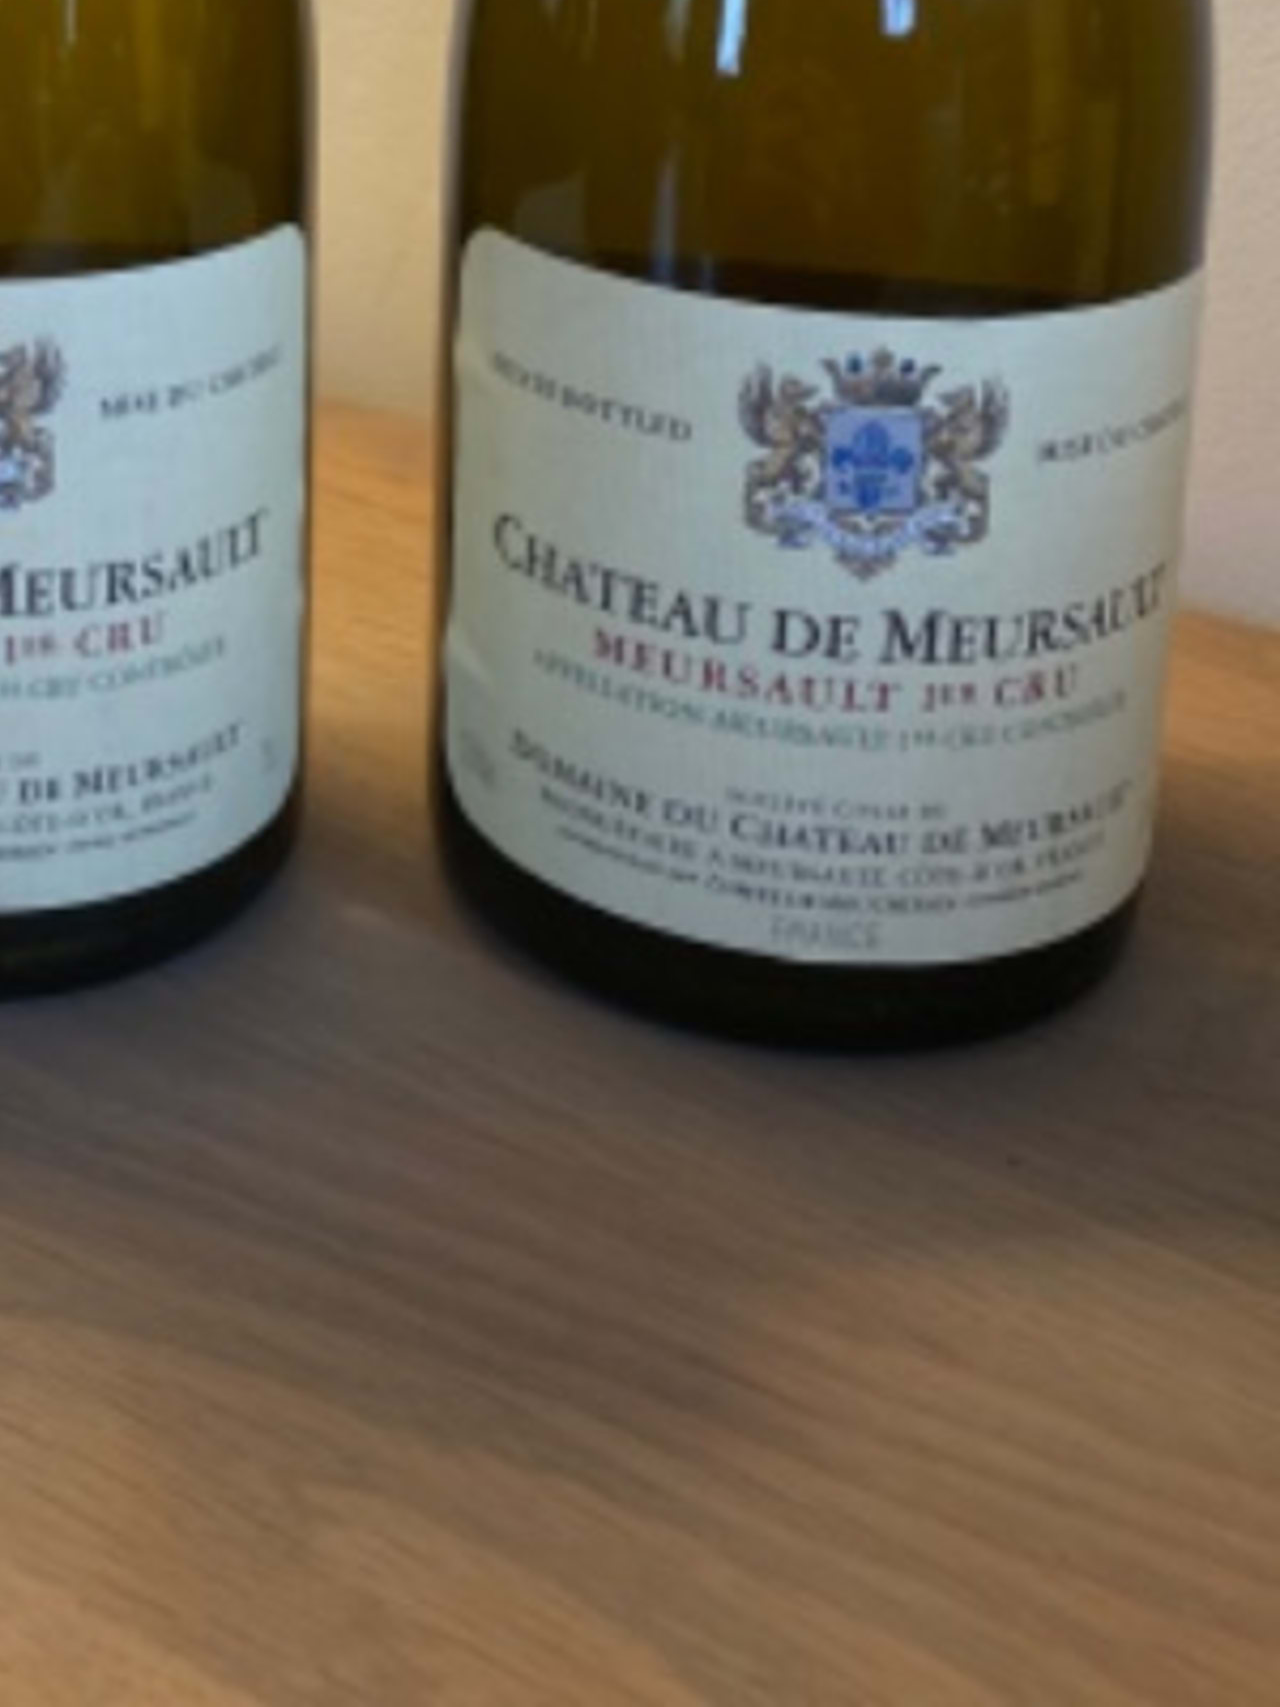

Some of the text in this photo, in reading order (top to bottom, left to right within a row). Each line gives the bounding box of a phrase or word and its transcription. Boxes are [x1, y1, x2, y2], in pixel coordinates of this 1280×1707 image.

[561, 384, 692, 442] BOTTLED
[493, 510, 1168, 667] CHATEAU DE MEURSAULT
[74, 608, 166, 658] CRU
[594, 626, 904, 715] MEURSAULT
[992, 661, 1082, 707] CRU
[18, 776, 61, 803] DE
[508, 728, 649, 815] DOMAINE
[660, 799, 719, 834] DU
[728, 812, 913, 856] CHATEAU
